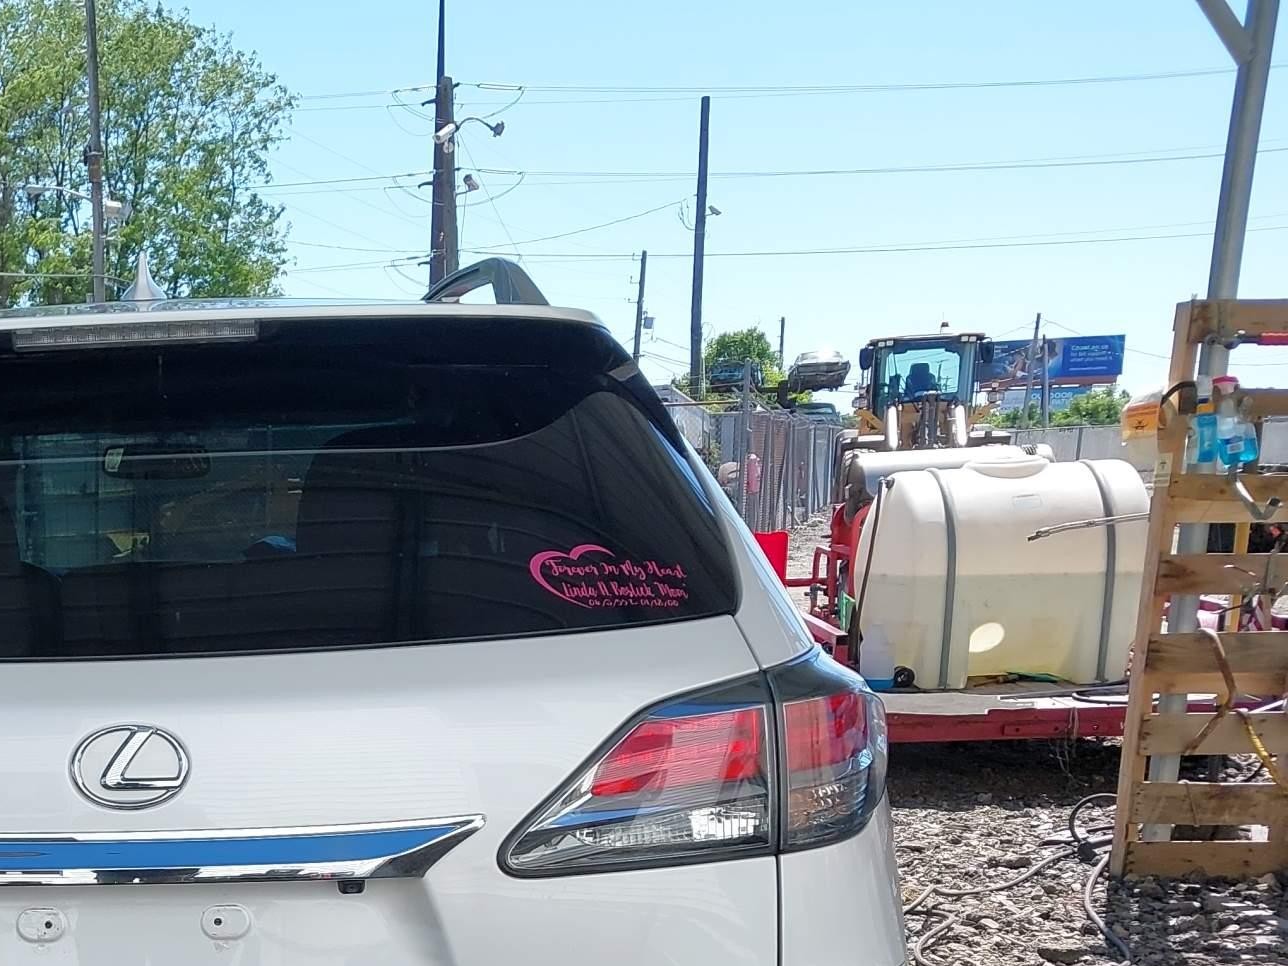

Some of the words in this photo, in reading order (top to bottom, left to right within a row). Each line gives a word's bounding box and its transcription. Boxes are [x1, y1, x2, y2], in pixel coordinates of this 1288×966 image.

[545, 559, 599, 577] Forever
[620, 559, 647, 580] My
[644, 561, 688, 579] Heart
